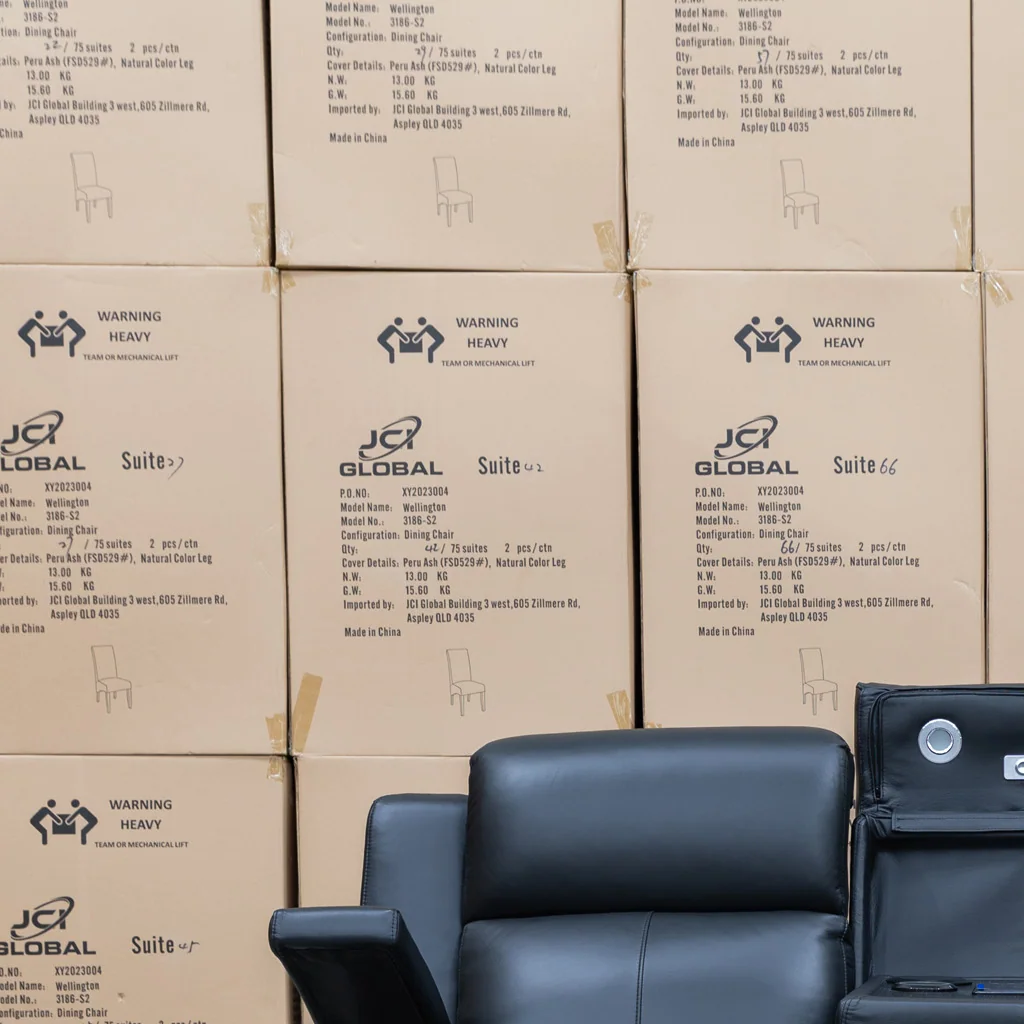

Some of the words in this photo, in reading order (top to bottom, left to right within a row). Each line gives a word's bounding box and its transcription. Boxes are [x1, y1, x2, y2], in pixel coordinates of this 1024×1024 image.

[739, 36, 766, 48] Dining
[768, 35, 789, 46] Chair
[29, 114, 56, 126] Aspley
[59, 114, 76, 125] QLD
[78, 114, 100, 125] 4035
[393, 118, 420, 131] Aspley
[422, 119, 439, 129] QLD
[441, 119, 462, 130] 4035
[329, 132, 352, 143] Made
[354, 133, 362, 143] in
[364, 132, 387, 143] China
[678, 137, 700, 147] Made
[702, 137, 710, 147] in
[712, 137, 735, 147] China
[97, 311, 161, 322] WARNING
[456, 317, 518, 328] WARNING
[813, 317, 875, 328] WARNING
[109, 331, 151, 342] HEAVY
[824, 337, 864, 348] HEAVY
[467, 338, 508, 348] HEAVY
[0, 456, 86, 471] LOBAL
[121, 451, 165, 470] Suite
[478, 456, 520, 475] Suite
[834, 455, 875, 474] Suite
[879, 458, 898, 475] 66
[339, 461, 443, 477] GLOBAL
[695, 460, 799, 476] GLOBAL
[402, 486, 449, 497] XY2023004
[340, 502, 365, 512] Model
[403, 502, 446, 514] Wellington
[341, 516, 365, 526] Model
[403, 515, 437, 525] 3186-S2
[404, 529, 431, 541] Dining
[432, 529, 454, 539] Chair
[697, 557, 720, 567] Cover
[757, 557, 776, 567] Peru
[778, 557, 792, 566] Ash
[850, 556, 880, 566] Natural
[882, 556, 903, 566] Color
[905, 556, 920, 567] Leg
[698, 599, 735, 611] Imported
[760, 598, 772, 608] JCI
[774, 598, 800, 608] Global
[802, 598, 836, 610] Building
[837, 597, 842, 608] 3
[884, 597, 918, 607] Zillmere
[51, 609, 78, 621] Aspley
[80, 609, 96, 619] QLD
[98, 609, 120, 619] 4035
[761, 612, 787, 624] Aspley
[789, 612, 805, 622] QLD
[807, 612, 828, 622] 4035
[344, 627, 366, 637] Made
[368, 627, 376, 637] in
[378, 627, 401, 637] China
[109, 799, 172, 810] WARNING
[121, 819, 162, 830] HEAVY
[132, 936, 174, 954] Suite
